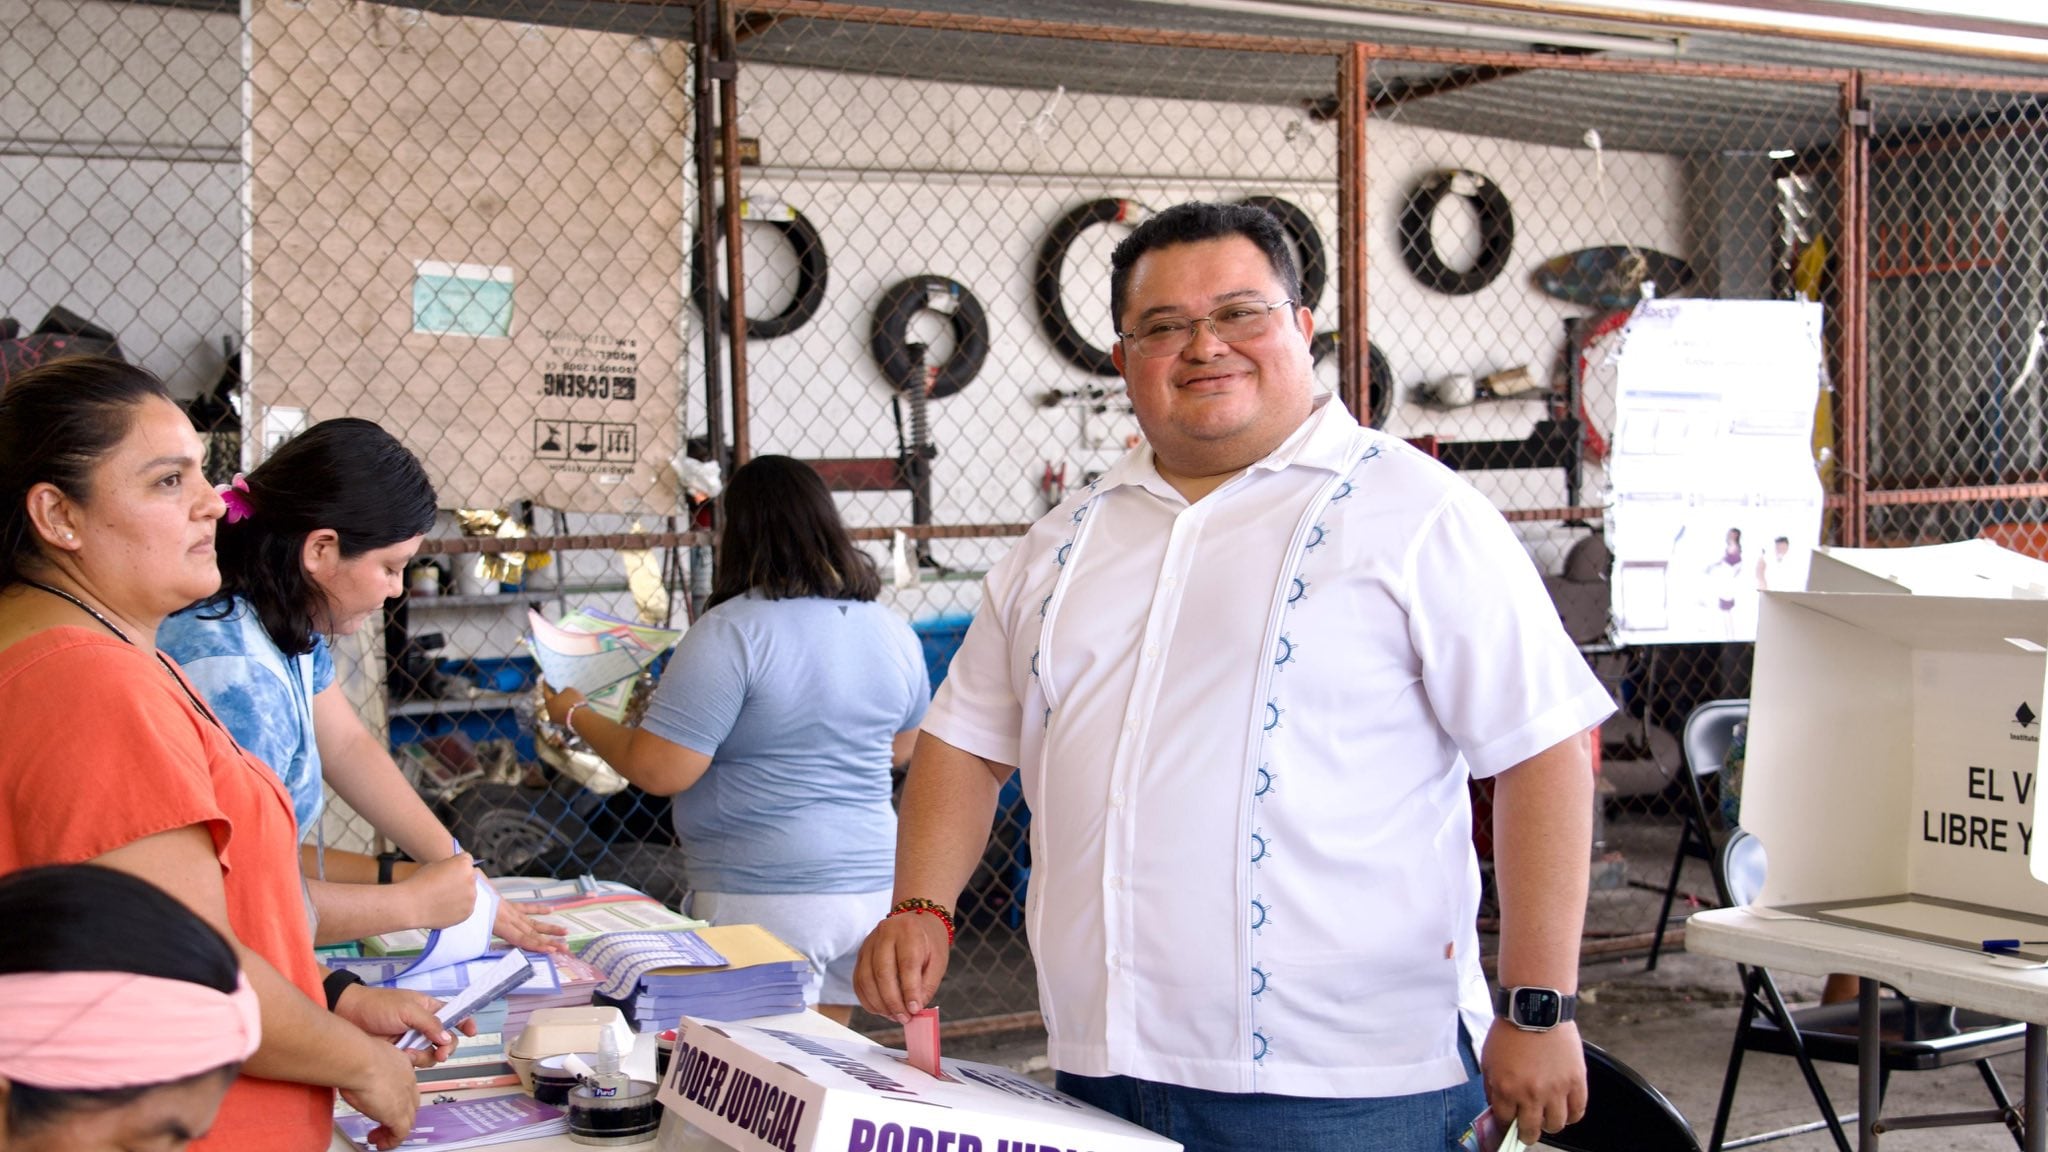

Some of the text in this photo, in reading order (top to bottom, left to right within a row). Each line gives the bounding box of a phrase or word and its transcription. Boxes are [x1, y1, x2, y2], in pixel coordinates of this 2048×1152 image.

[544, 373, 609, 399] COSENG
[2010, 732, 2039, 742] Instituto
[1969, 766, 2036, 805] EL V
[1924, 810, 2008, 852] LIBRE
[670, 1041, 806, 1152] PODER JUDICIAL
